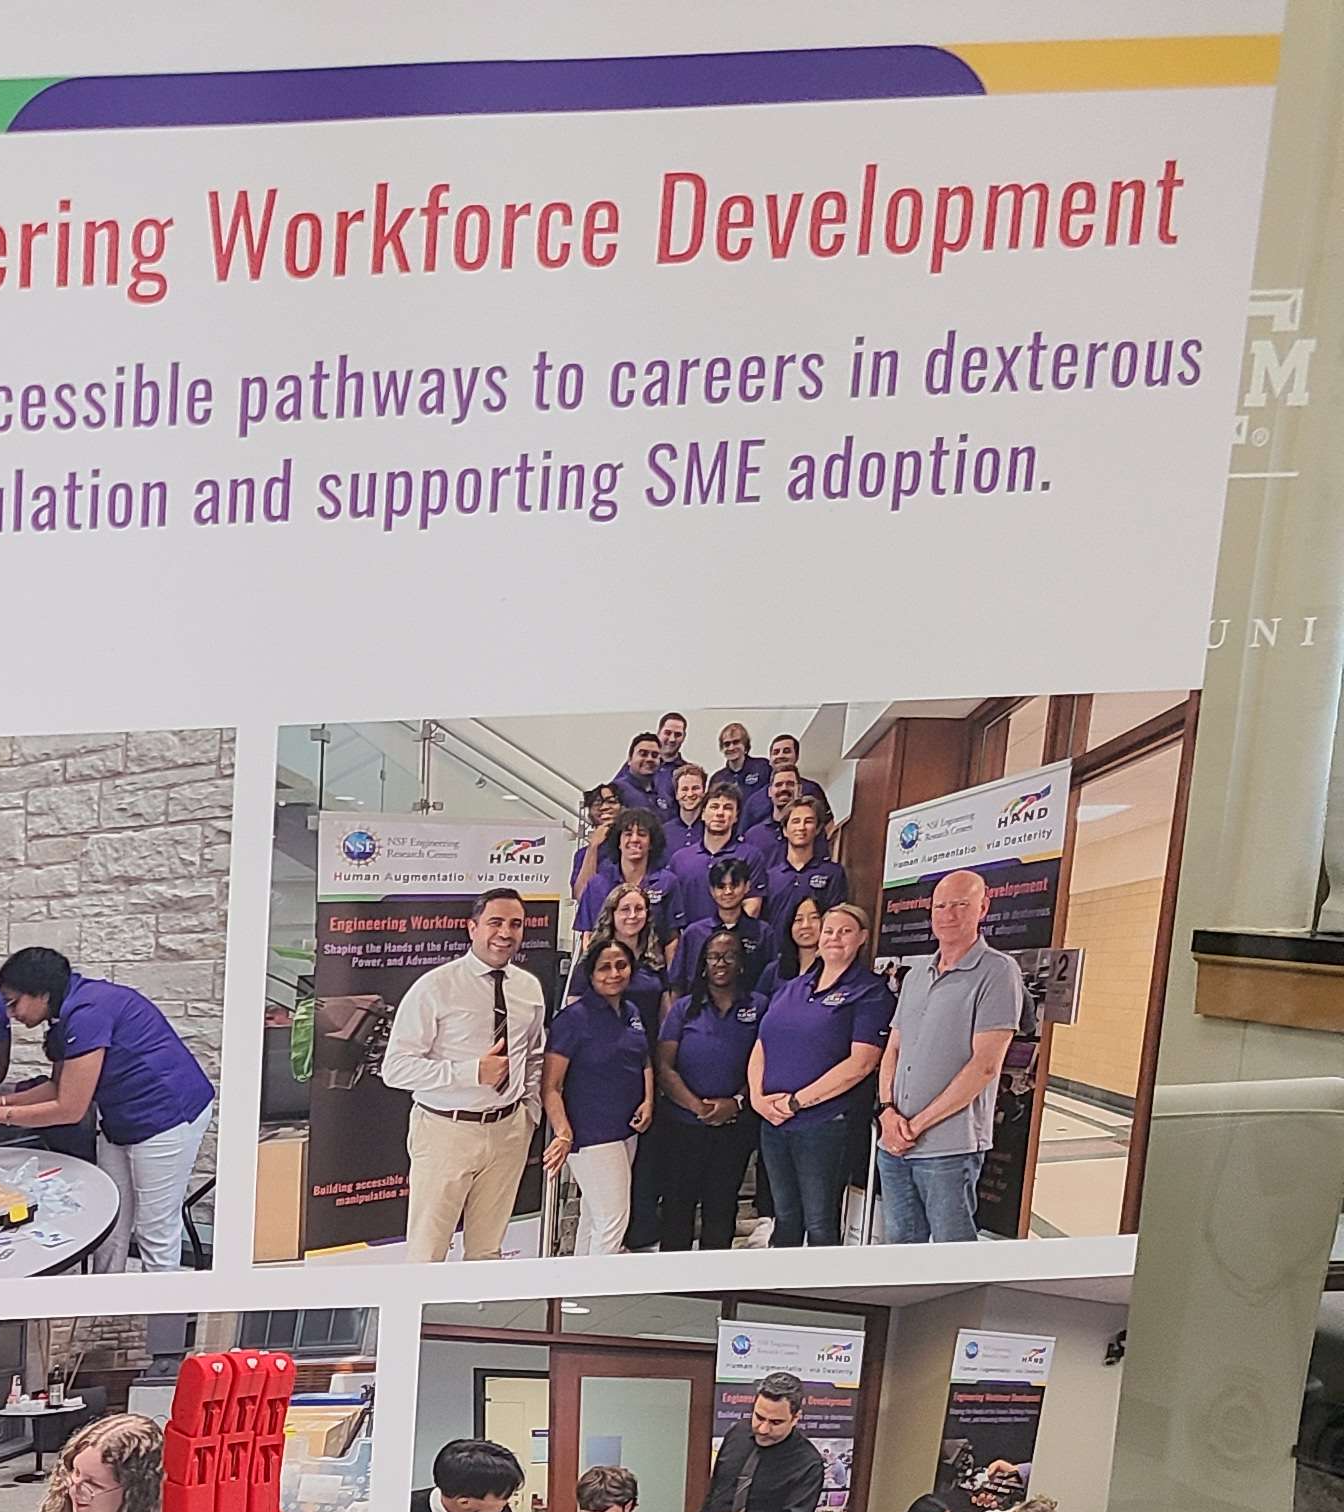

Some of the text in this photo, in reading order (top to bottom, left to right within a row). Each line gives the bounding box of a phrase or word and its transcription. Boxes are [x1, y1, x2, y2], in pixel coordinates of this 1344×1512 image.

[208, 181, 620, 282] Workforce
[656, 159, 1185, 275] Development
[238, 355, 508, 438] pathways
[534, 350, 586, 413] to
[609, 352, 824, 409] careers
[851, 341, 900, 398] in
[926, 327, 1204, 397] dexterous
[192, 458, 293, 526] and
[318, 453, 619, 530] supporting
[644, 438, 762, 508] SME
[786, 438, 1054, 513] adoption.
[997, 807, 1049, 829] HAND
[986, 839, 1001, 850] via
[1003, 828, 1053, 846] Dexterity
[489, 853, 545, 865] HAND
[334, 871, 380, 881] Human
[477, 872, 495, 882] via
[499, 872, 551, 884] Dexterity
[329, 916, 407, 933] Engineering
[323, 943, 363, 956] Shaping
[365, 943, 382, 954] the
[384, 942, 412, 953] Hands
[414, 942, 425, 953] of
[426, 941, 442, 952] the
[351, 957, 385, 968] Power,
[386, 956, 404, 966] and
[313, 1182, 354, 1196] Building
[356, 1175, 403, 1190] accessible
[336, 1190, 397, 1206] manipulation
[817, 1353, 851, 1363] HAND
